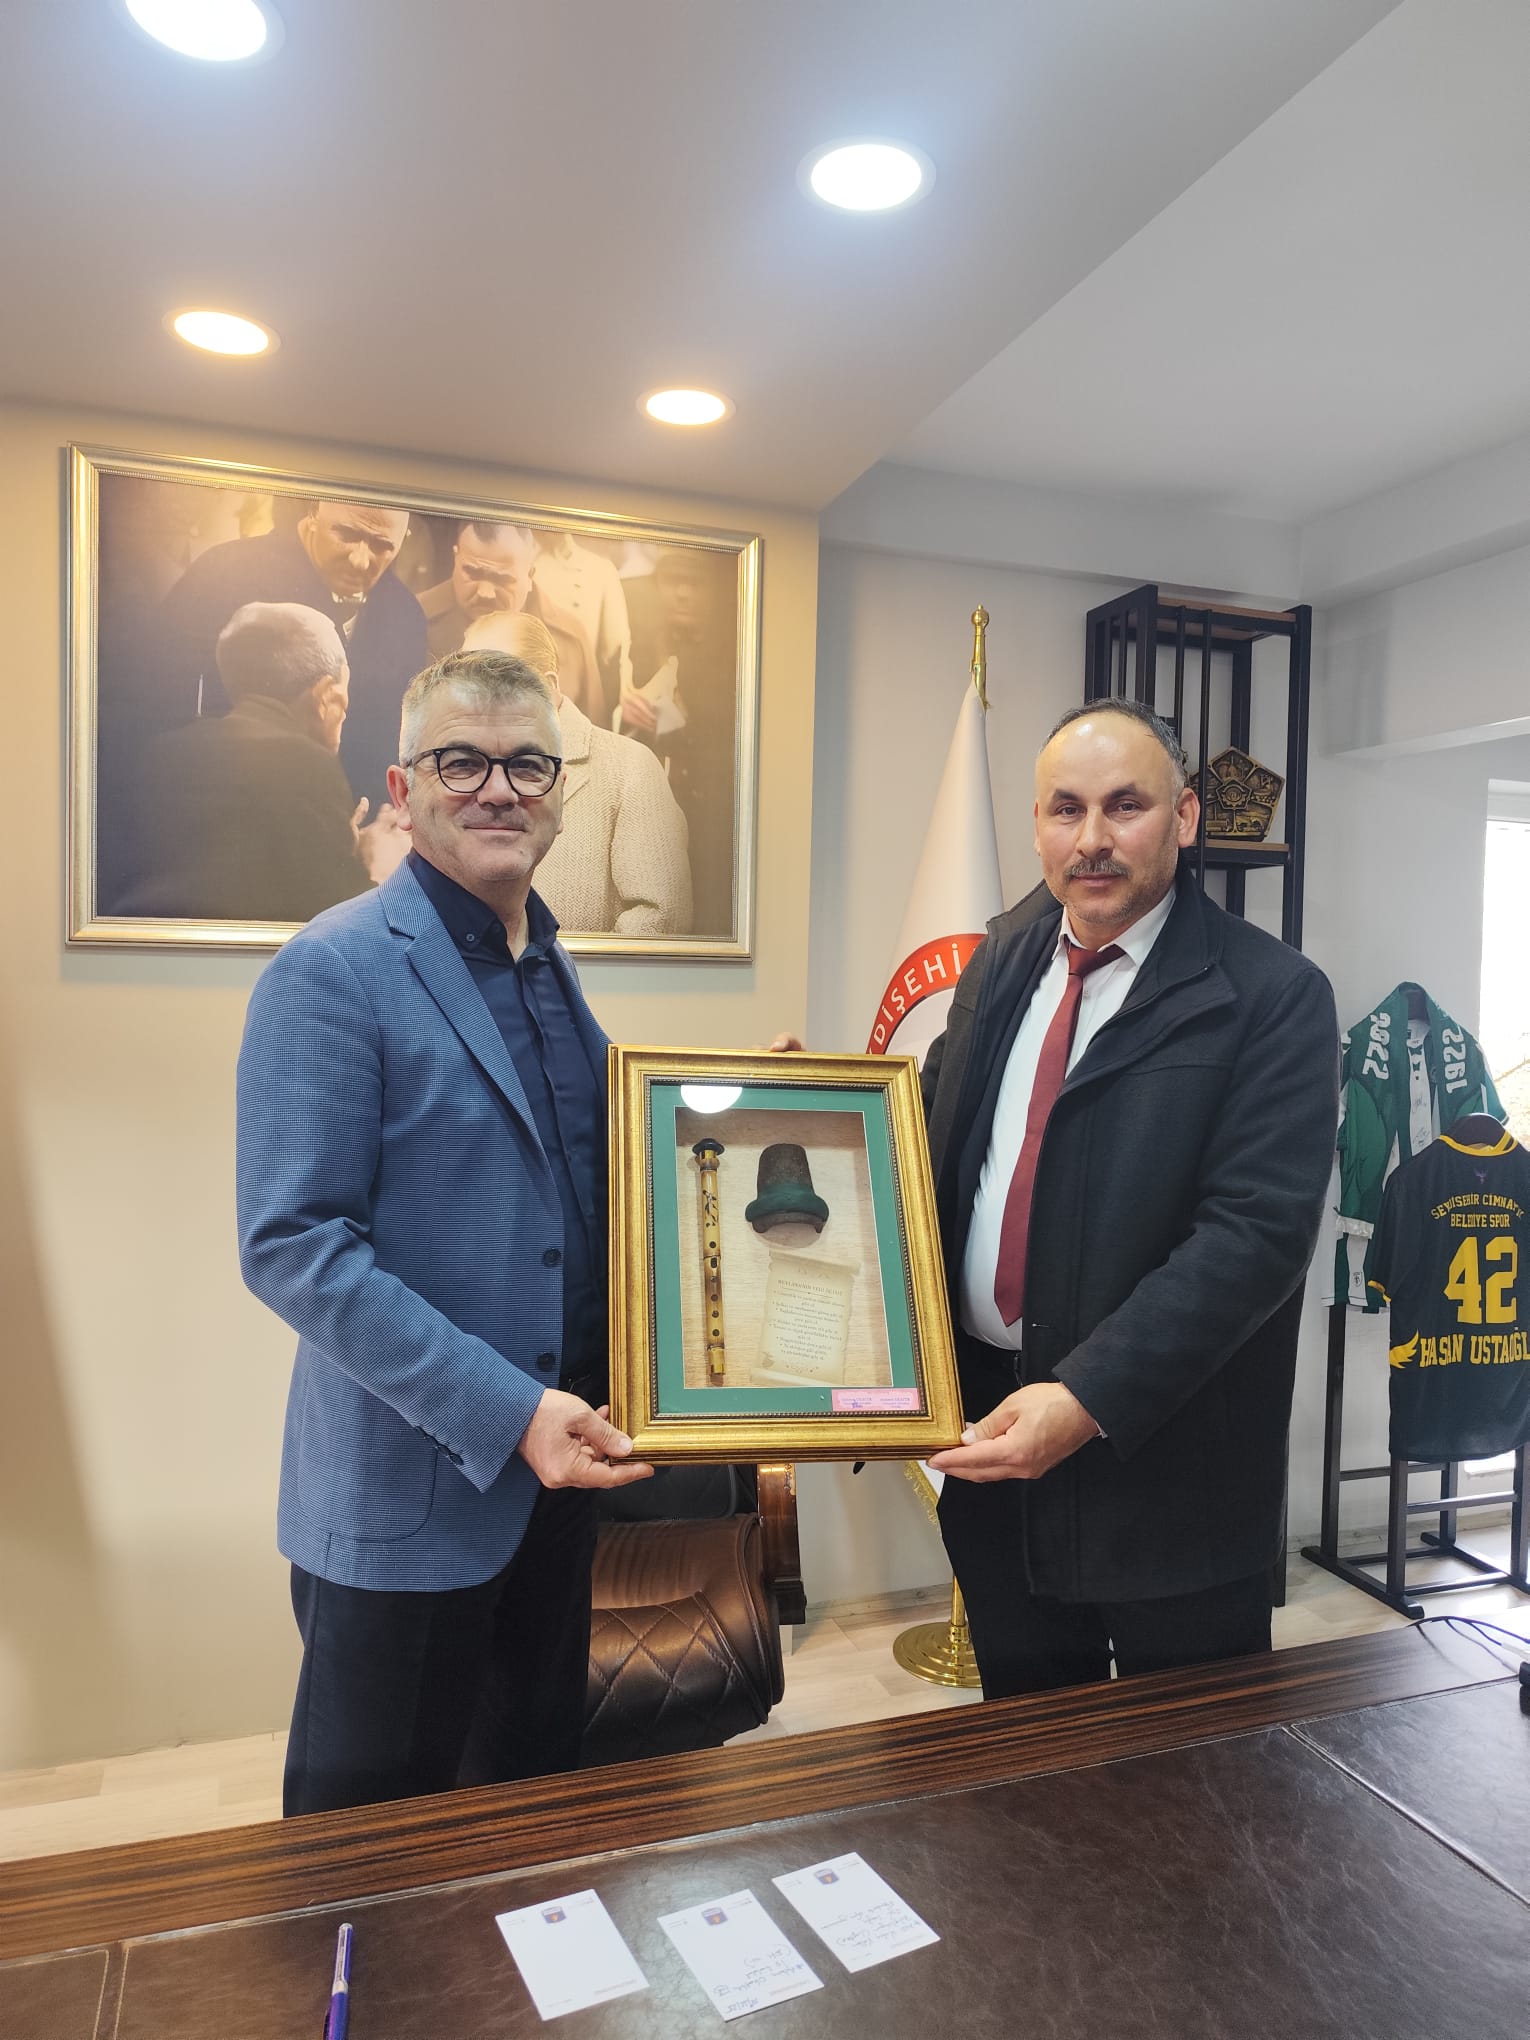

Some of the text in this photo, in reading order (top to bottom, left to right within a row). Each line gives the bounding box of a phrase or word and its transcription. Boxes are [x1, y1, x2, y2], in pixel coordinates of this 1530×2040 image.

[869, 943, 976, 1056] DİŞEHİ
[1362, 1012, 1391, 1080] 2022
[1442, 1025, 1468, 1094] 1922
[1489, 1213, 1511, 1228] SPOR
[1443, 1236, 1518, 1325] 42
[1419, 1333, 1465, 1368] HASAN
